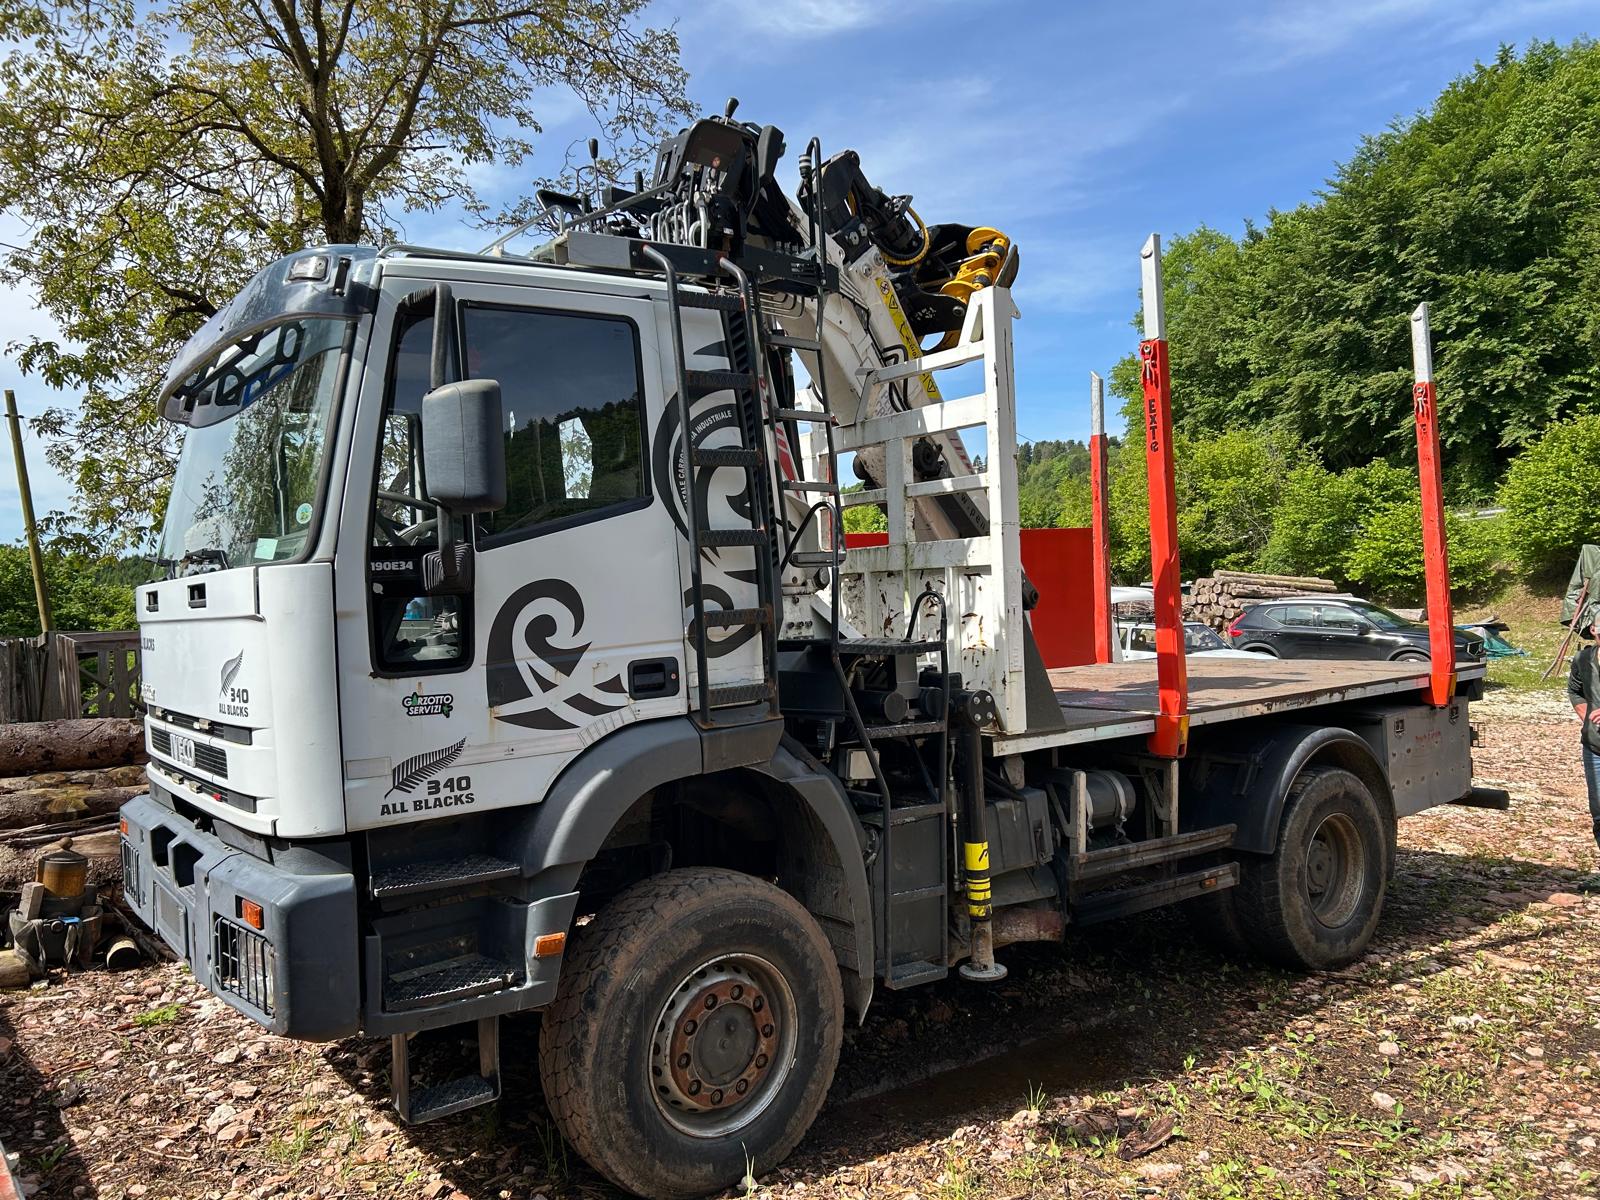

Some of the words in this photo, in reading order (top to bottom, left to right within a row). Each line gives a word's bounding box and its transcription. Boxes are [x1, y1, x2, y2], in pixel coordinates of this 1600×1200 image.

[695, 410, 732, 434] INDUSTRIALE
[370, 561, 413, 571] 190E34
[230, 687, 249, 704] 340
[227, 704, 249, 718] BLACKS
[408, 704, 442, 715] SERVIZI
[170, 733, 195, 768] IVECO
[427, 775, 472, 796] 340
[380, 801, 408, 816] ALL
[412, 792, 475, 812] BLACKS
